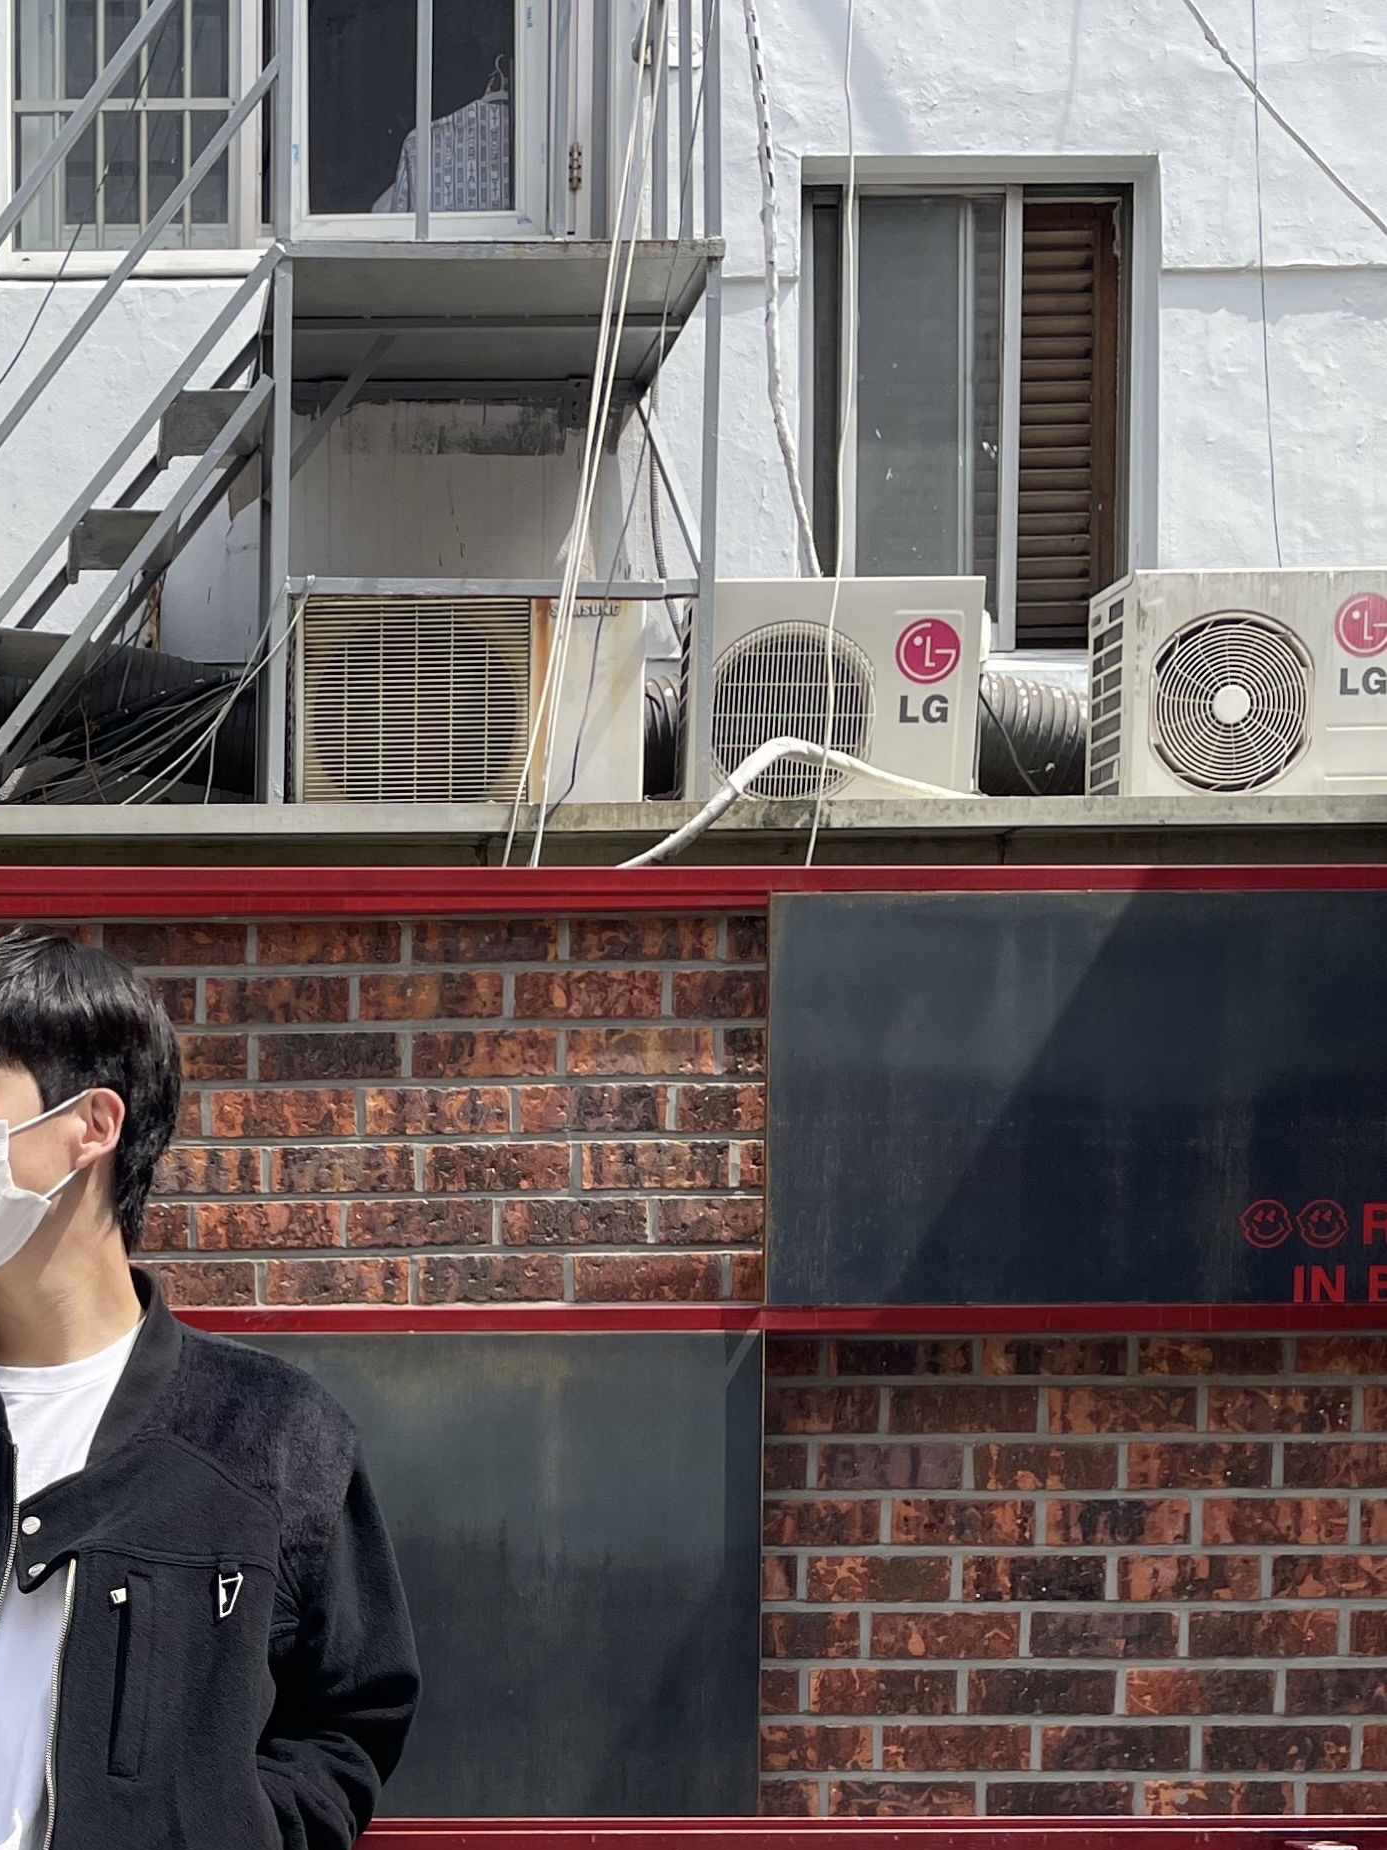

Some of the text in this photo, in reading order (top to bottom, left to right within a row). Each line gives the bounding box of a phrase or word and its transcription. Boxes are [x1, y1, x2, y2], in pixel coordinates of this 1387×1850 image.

[550, 603, 620, 618] SMSUNG
[1339, 666, 1387, 695] LG
[899, 693, 949, 723] LG
[1293, 1265, 1345, 1302] IN
